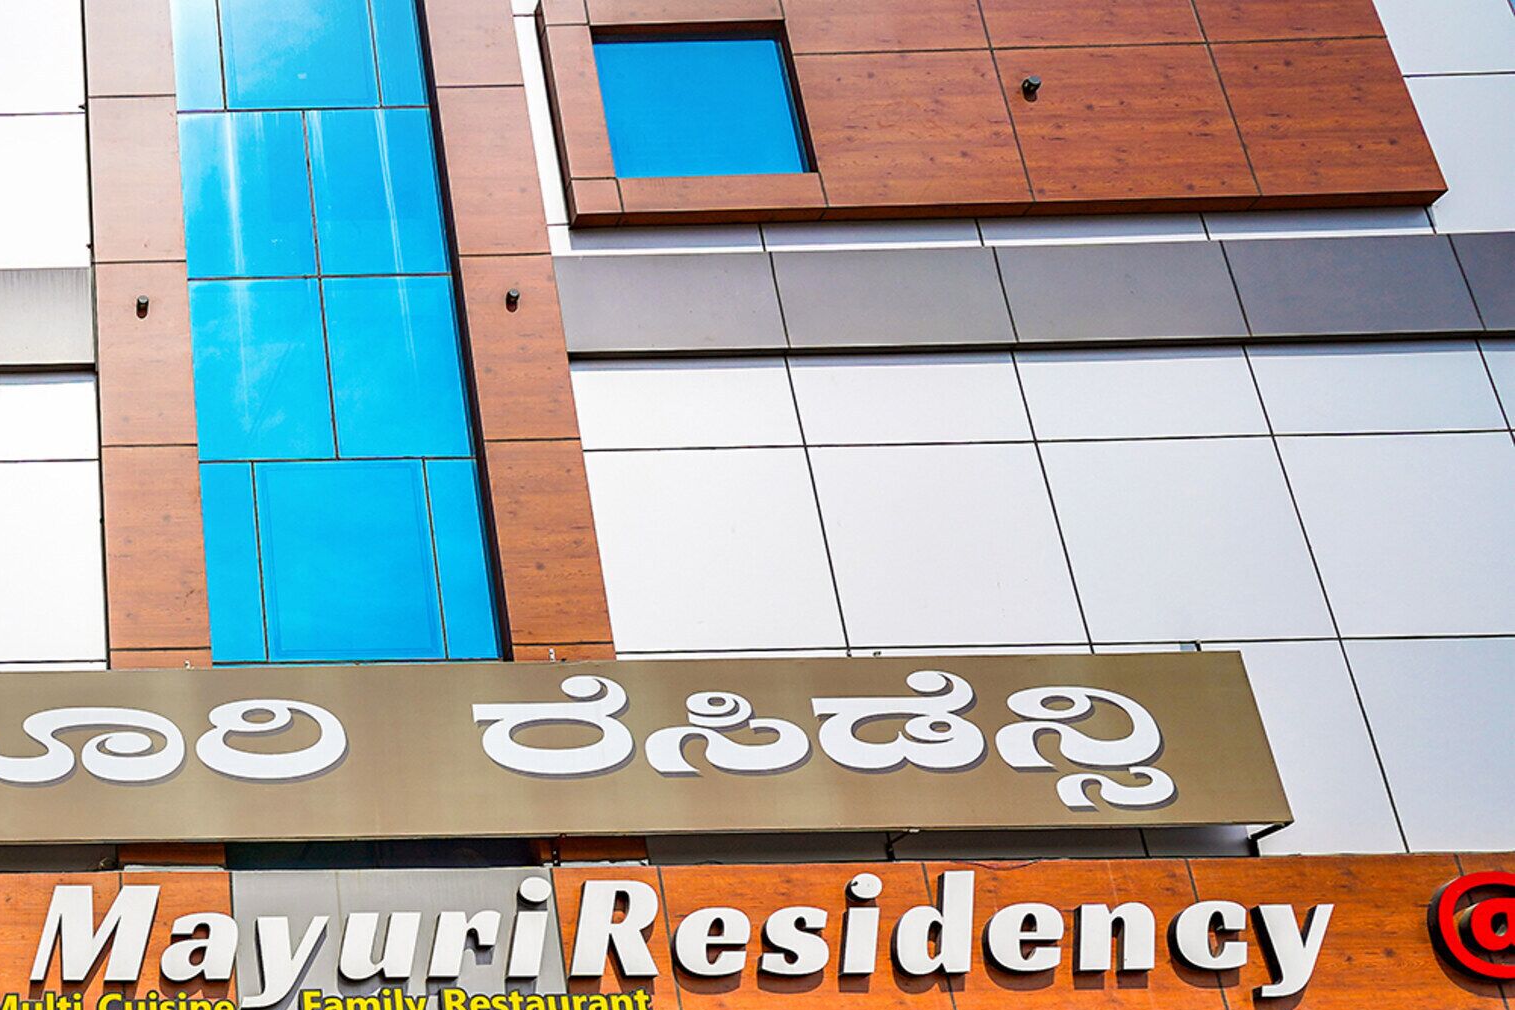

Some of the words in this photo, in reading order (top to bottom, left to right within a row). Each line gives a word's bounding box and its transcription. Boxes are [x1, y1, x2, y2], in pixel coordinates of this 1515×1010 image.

[471, 670, 1176, 812] ರೆಸಿಡೆನ್ಸಿ
[30, 877, 552, 1008] Mayuri
[570, 870, 1334, 998] Residency
